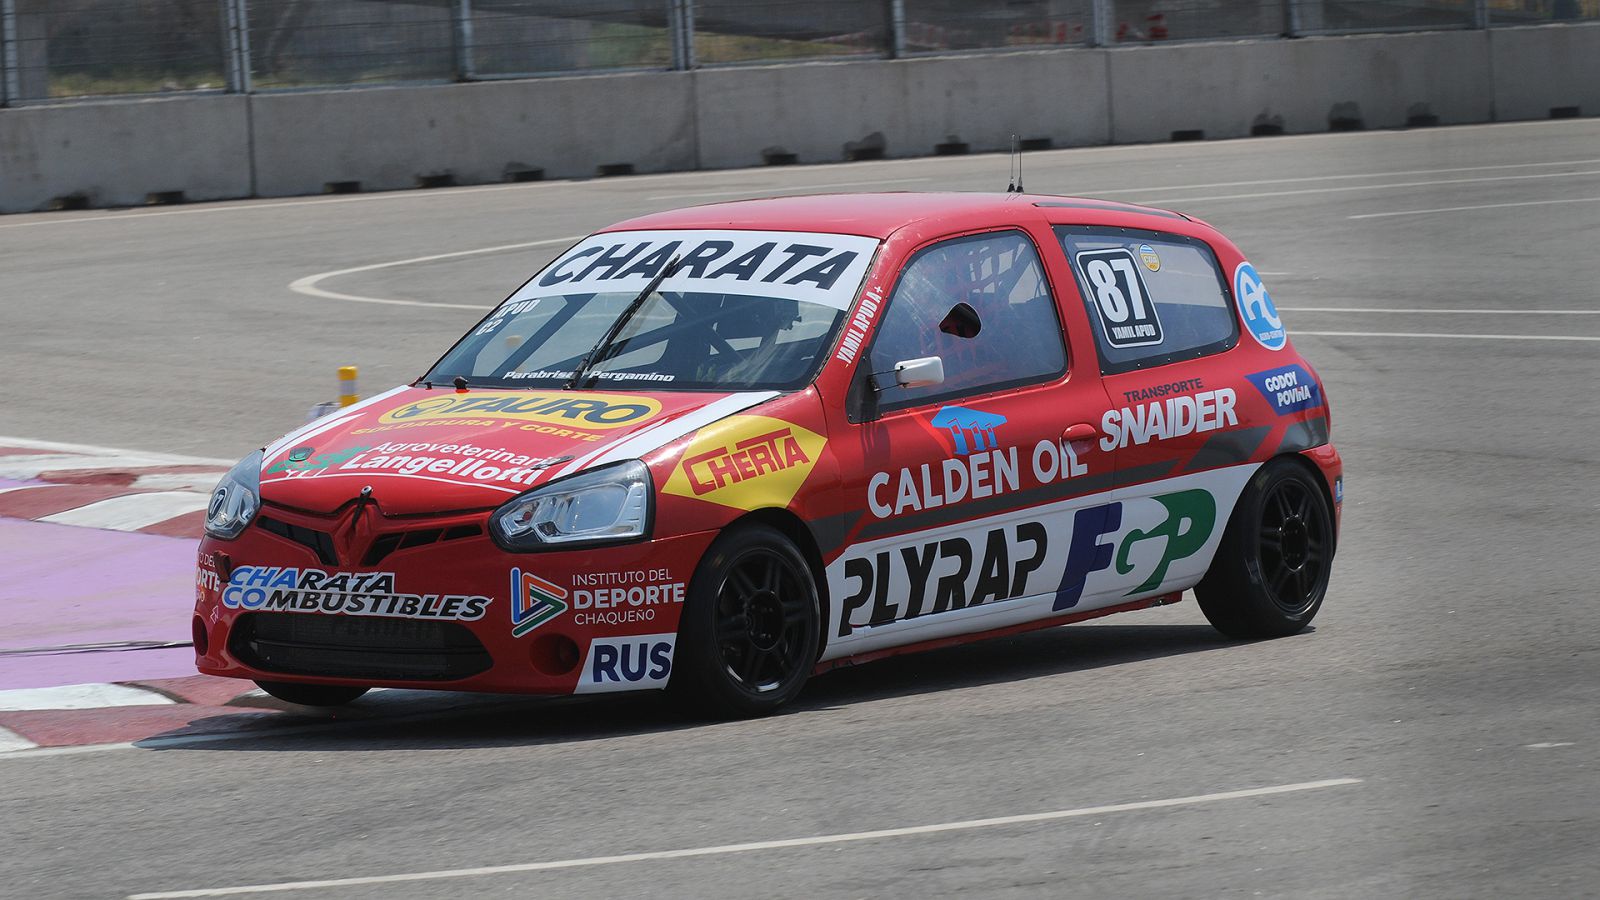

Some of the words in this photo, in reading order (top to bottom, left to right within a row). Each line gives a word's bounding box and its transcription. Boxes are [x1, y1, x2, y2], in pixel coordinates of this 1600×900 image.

[539, 241, 860, 291] CHARATA
[1087, 258, 1146, 323] 87
[836, 328, 865, 364] YAMIL
[853, 300, 878, 333] APUD
[1112, 326, 1136, 340] YAMIL
[1135, 324, 1156, 338] APUD
[589, 371, 675, 382] Pergamino
[1265, 371, 1298, 392] GODOY
[1124, 378, 1205, 403] TRANSPORTE
[457, 397, 651, 424] TAURO
[1101, 388, 1239, 452] SNAIDER
[502, 421, 521, 429] Y
[520, 423, 606, 442] CORTE
[340, 453, 549, 485] Langellotti
[867, 446, 1019, 519] CALDEN
[1032, 439, 1088, 484] OIL
[229, 566, 395, 593] CHARATA
[572, 571, 645, 586] INSTITUTO
[649, 569, 673, 581] DEL
[837, 521, 1048, 638] PLYRAP
[224, 589, 489, 619] COMBUSTIBLES
[573, 582, 685, 609] DEPORTE
[574, 609, 655, 625] CHAQUEÑO
[592, 642, 672, 683] RUS
